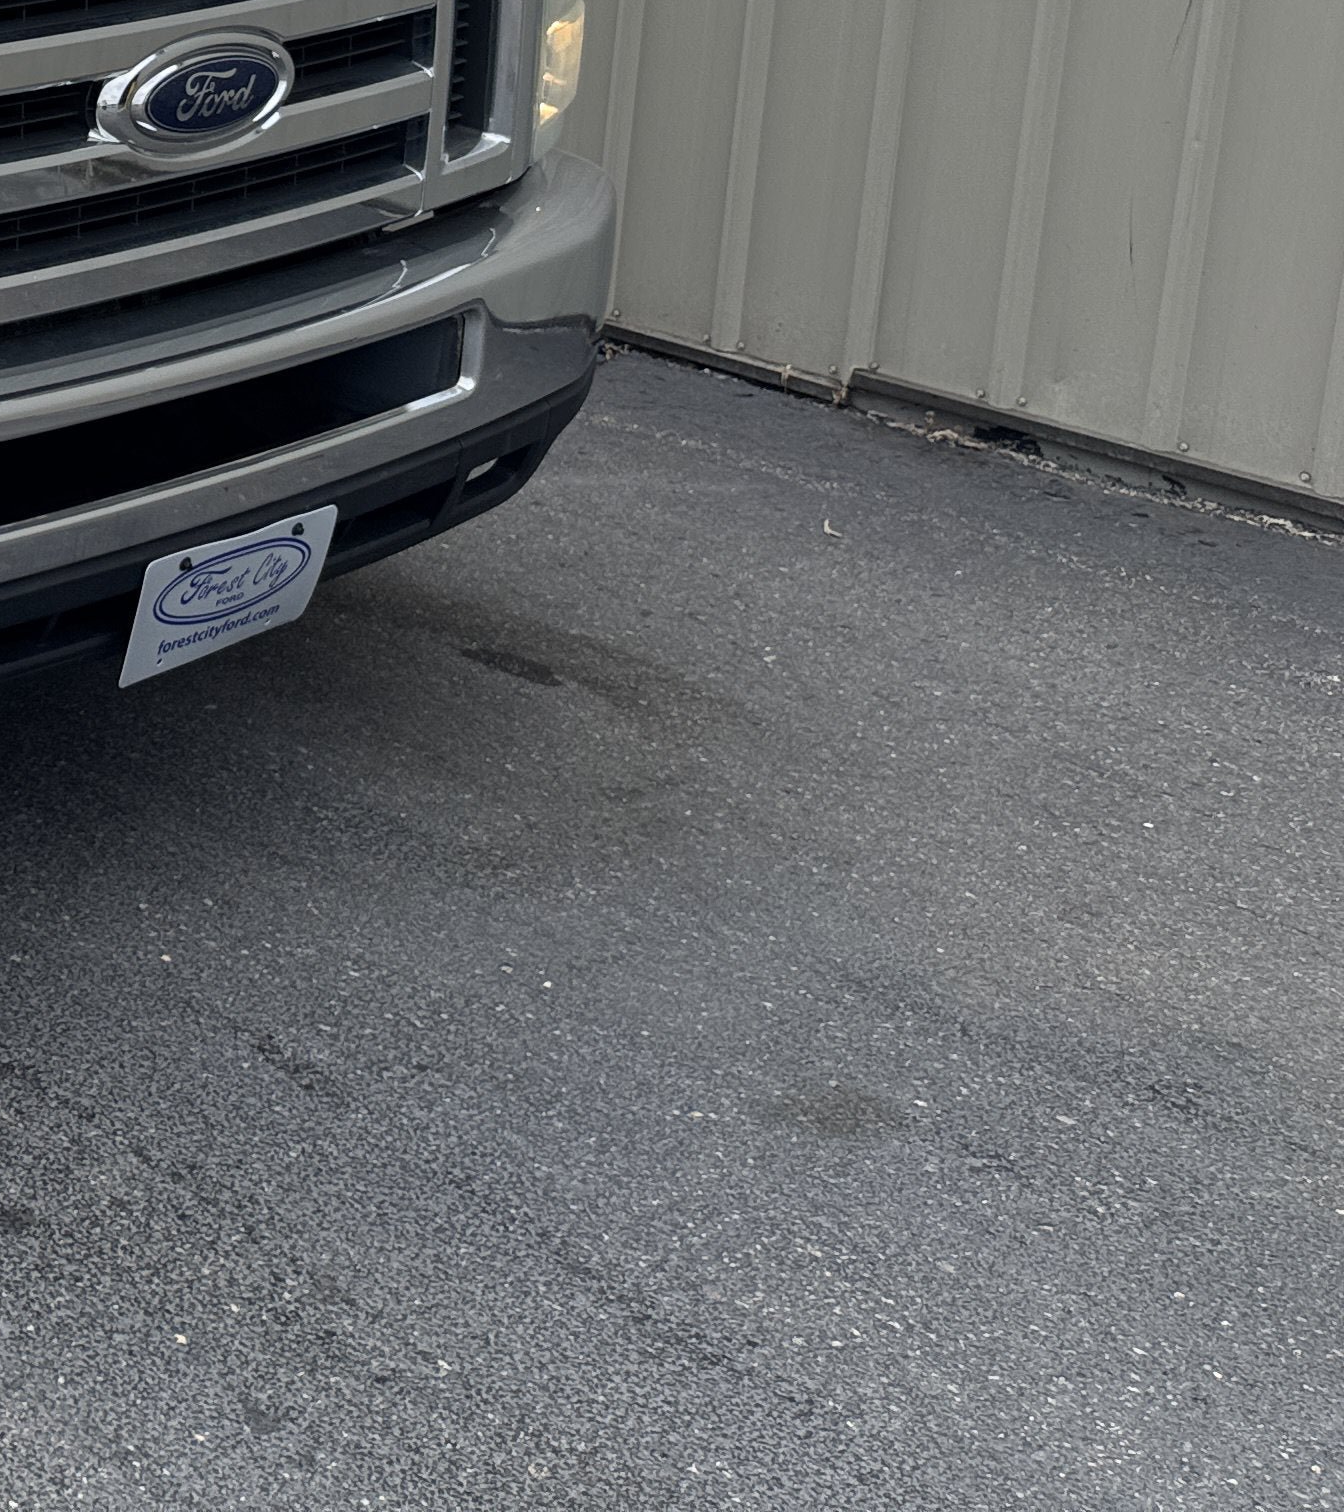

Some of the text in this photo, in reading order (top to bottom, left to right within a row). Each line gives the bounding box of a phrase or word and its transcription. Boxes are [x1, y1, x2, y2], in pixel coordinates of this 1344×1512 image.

[176, 68, 257, 122] Ford
[180, 552, 289, 605] Forest City
[216, 592, 244, 606] FORD
[157, 604, 280, 655] forestcityford.com
